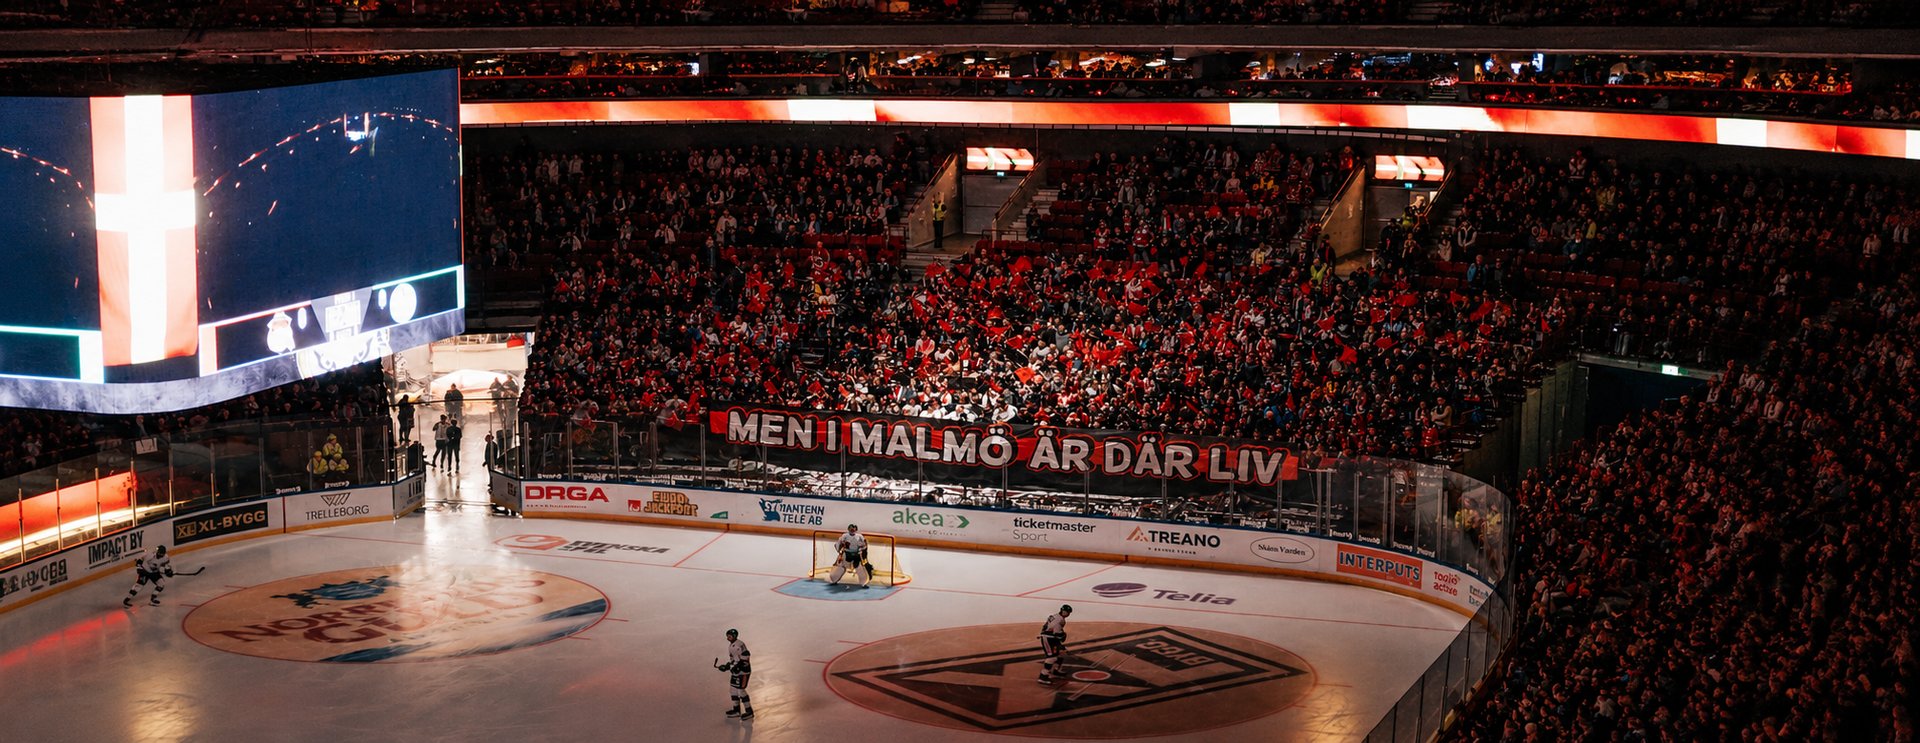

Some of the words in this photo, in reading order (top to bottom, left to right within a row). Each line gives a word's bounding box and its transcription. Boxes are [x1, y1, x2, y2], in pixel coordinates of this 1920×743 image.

[728, 410, 812, 450] MEN
[826, 420, 837, 451] I
[851, 421, 1012, 466] MALMÖ
[1030, 428, 1090, 471] ÄR
[1104, 435, 1193, 479] DÄR
[1208, 447, 1283, 484] LIV
[525, 485, 609, 503] DRGA
[199, 510, 266, 532] XL-BYGG
[306, 504, 369, 521] TRELLEBORG
[782, 513, 806, 524] TELE
[808, 515, 823, 526] AB
[892, 507, 944, 527] akea
[1013, 517, 1096, 533] ticketmaster
[1013, 529, 1048, 543] Sport
[1148, 529, 1221, 548] TREANO
[88, 535, 128, 565] IMPACT
[130, 530, 144, 550] BY
[1339, 551, 1420, 581] INTERPUTS
[1153, 588, 1238, 606] Telia
